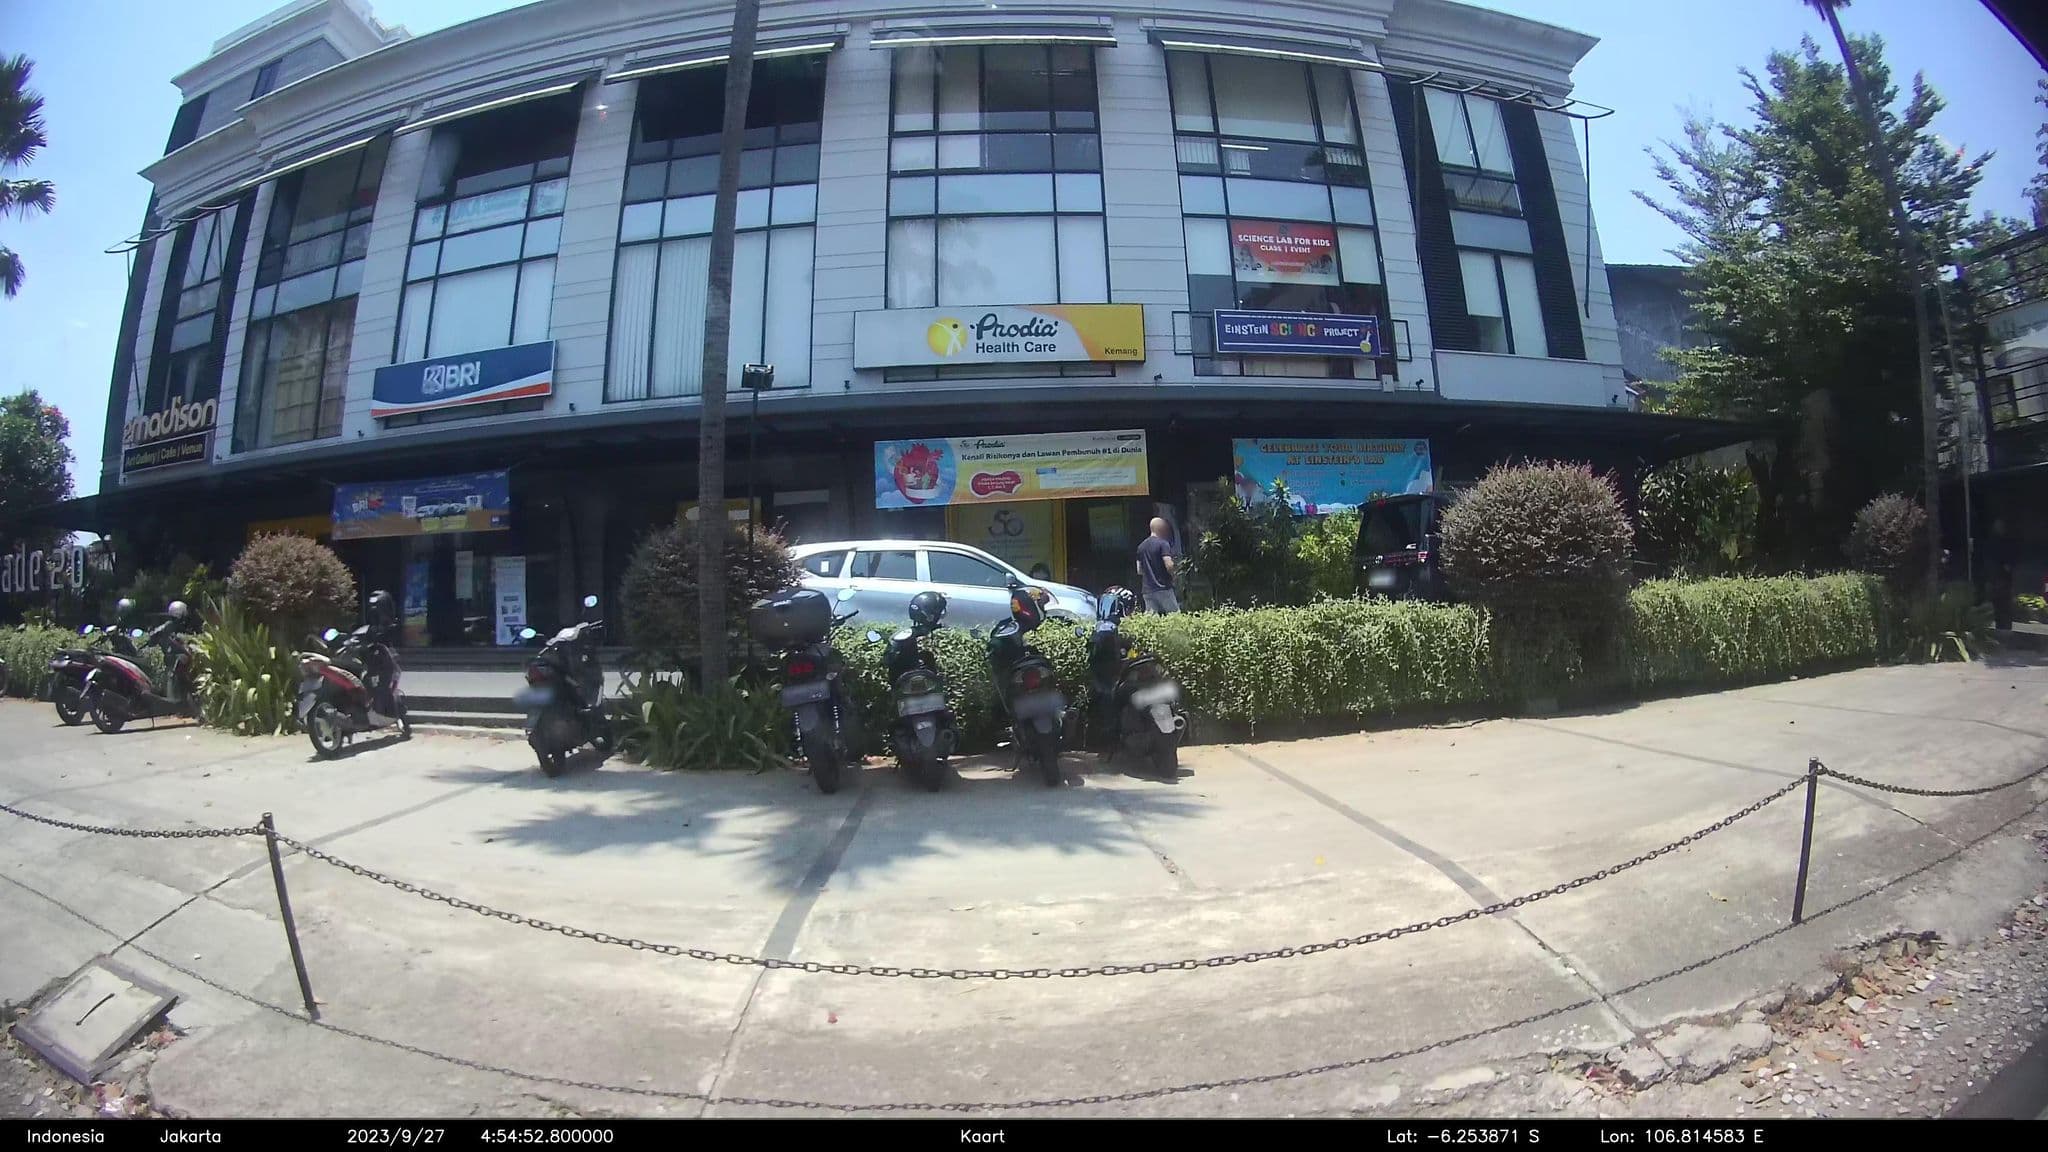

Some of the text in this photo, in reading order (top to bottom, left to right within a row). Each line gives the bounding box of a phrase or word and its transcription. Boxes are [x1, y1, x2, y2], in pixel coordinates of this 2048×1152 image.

[1238, 234, 1331, 247] SCIENCE LAB FOR KIDS
[1260, 244, 1282, 252] CLASS
[1290, 246, 1311, 254] EVENT
[970, 313, 1059, 340] Prodia
[1323, 327, 1359, 337] PROJECT
[976, 340, 1056, 354] Health Care
[1104, 346, 1138, 357] Kemang
[446, 361, 481, 387] BRI
[986, 451, 1021, 461] Risikonya
[1022, 450, 1036, 458] dan
[1037, 449, 1061, 458] Lawan
[1062, 447, 1101, 456] Pembunuh
[1121, 445, 1142, 454] Dunia
